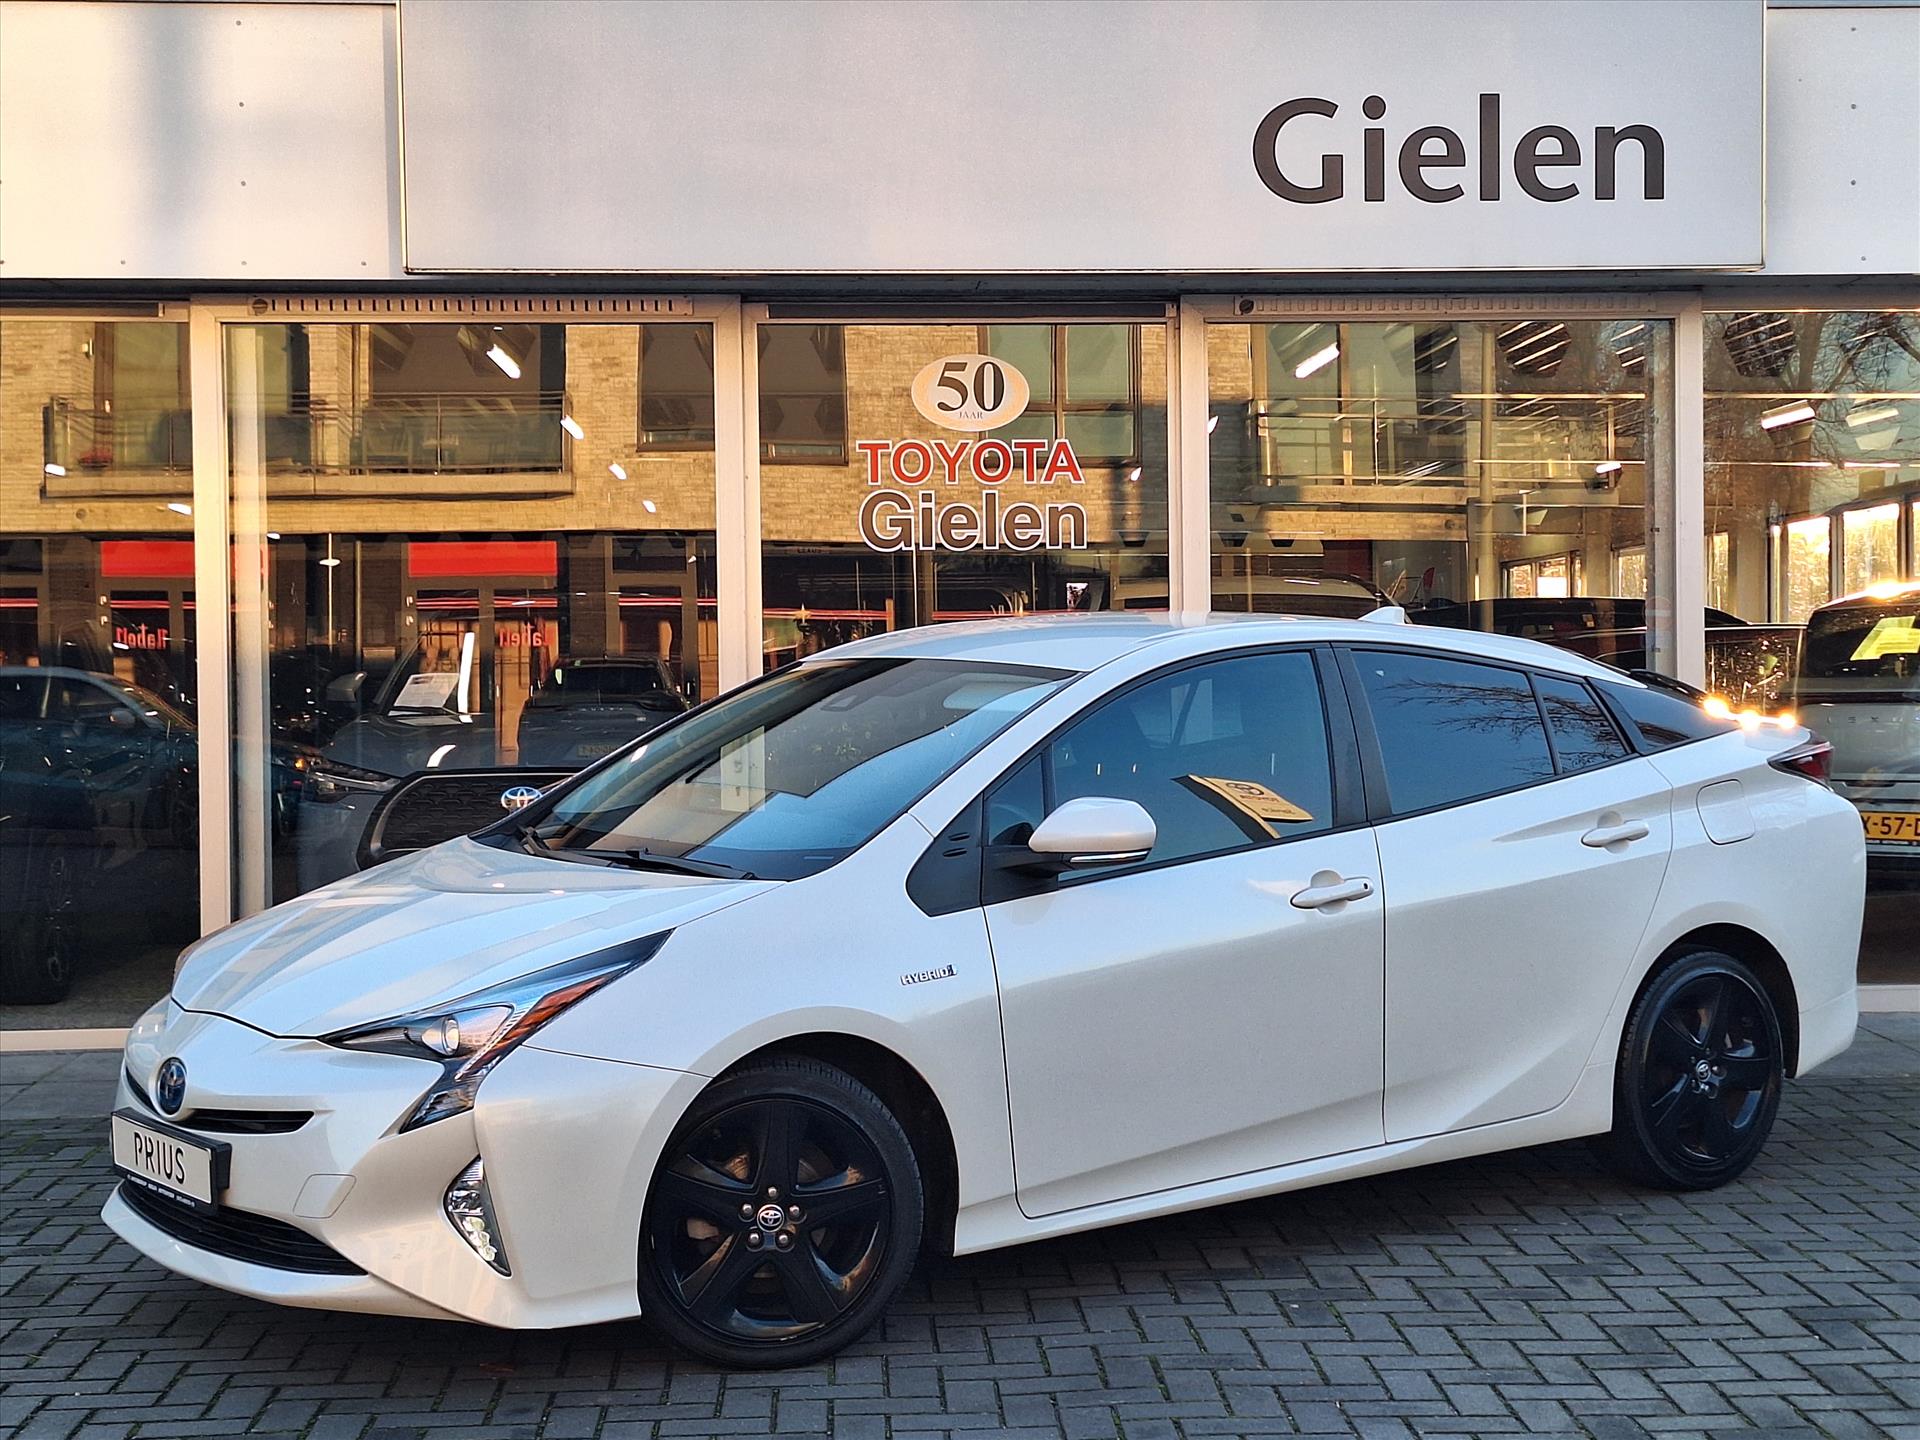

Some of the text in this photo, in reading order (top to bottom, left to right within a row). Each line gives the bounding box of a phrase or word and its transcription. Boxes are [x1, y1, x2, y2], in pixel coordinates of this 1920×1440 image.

[1252, 93, 1666, 204] Gielen
[937, 361, 1005, 411] 50
[959, 411, 983, 420] JAAR
[857, 440, 1085, 484] TOYOTA
[859, 490, 1087, 552] Gielen
[133, 1131, 186, 1185] PRIUS
